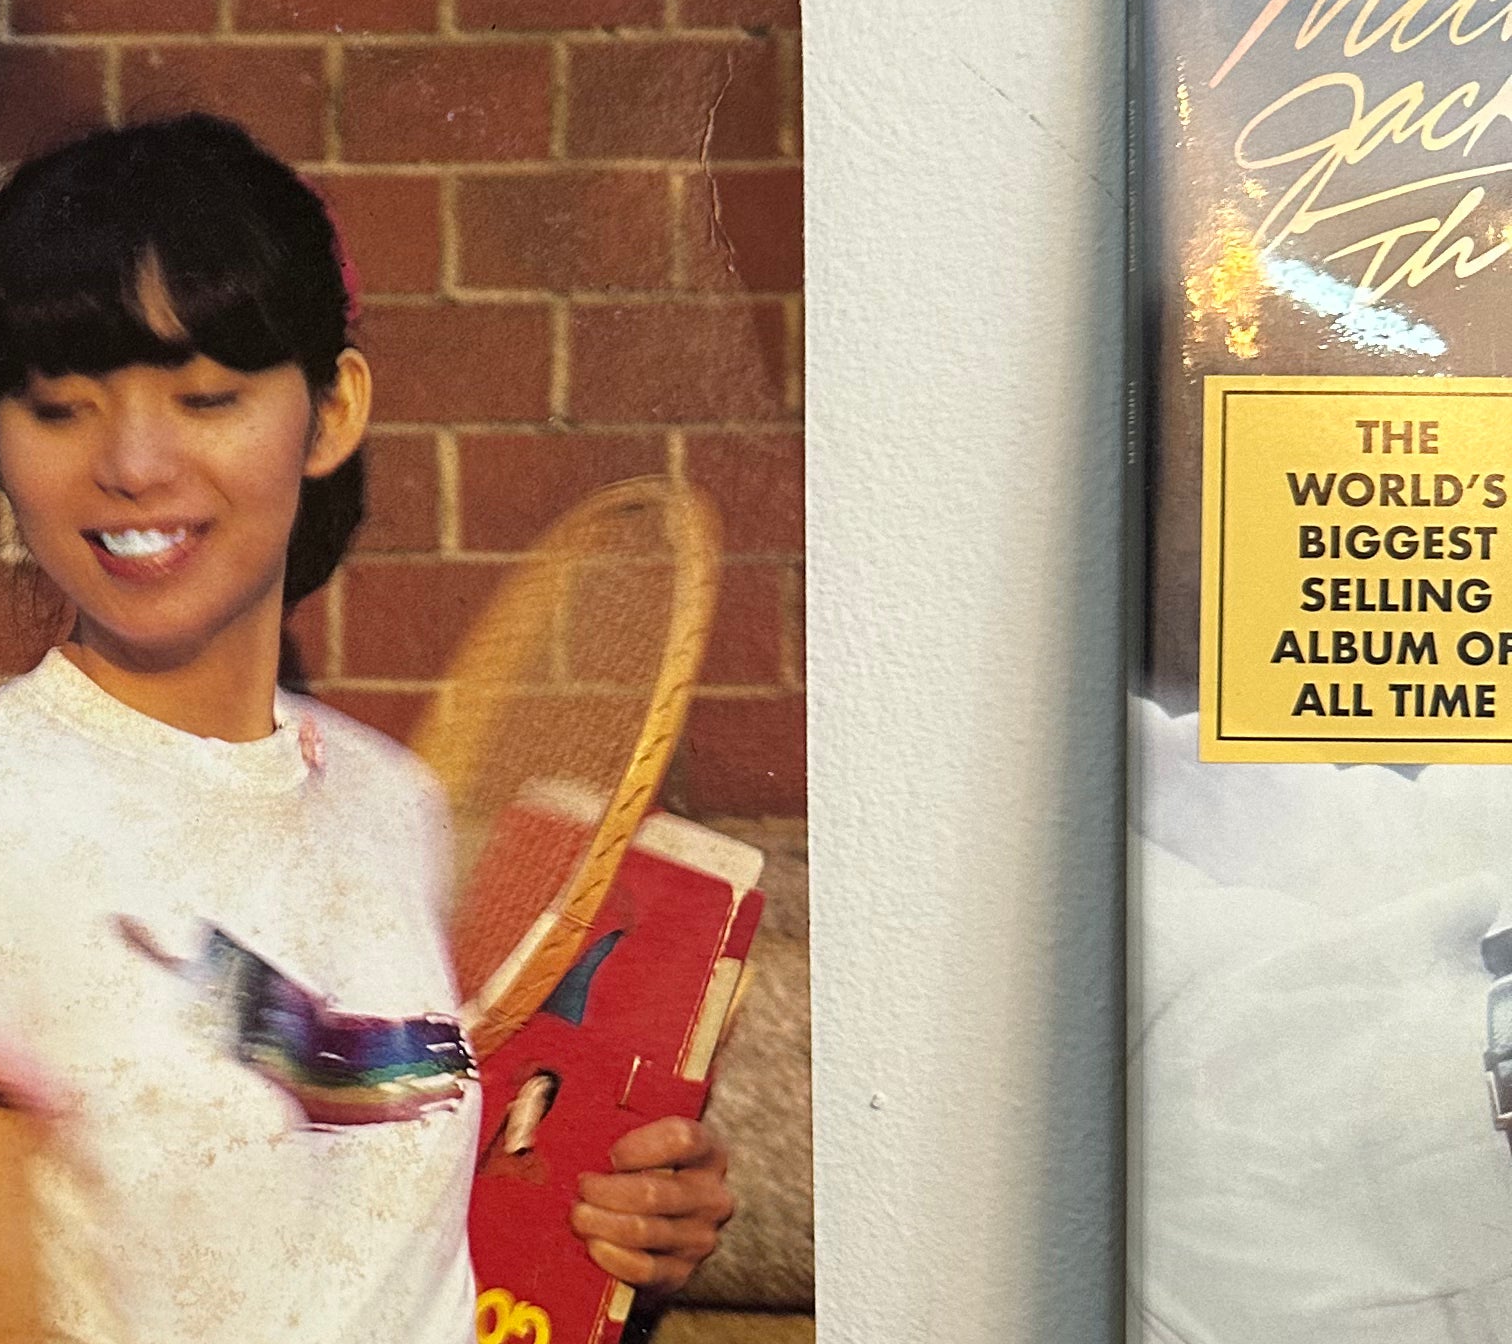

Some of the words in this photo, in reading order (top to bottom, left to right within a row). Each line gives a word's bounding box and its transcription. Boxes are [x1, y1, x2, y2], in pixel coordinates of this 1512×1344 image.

[1355, 420, 1439, 454] THE
[1285, 472, 1508, 508] WORLD'S
[1299, 525, 1497, 560] BIGGEST
[1300, 577, 1492, 613] SELLING
[1270, 630, 1438, 665] ALBUM
[1456, 631, 1512, 665] OF
[1291, 683, 1372, 717] ALL
[1389, 684, 1496, 718] TIME
